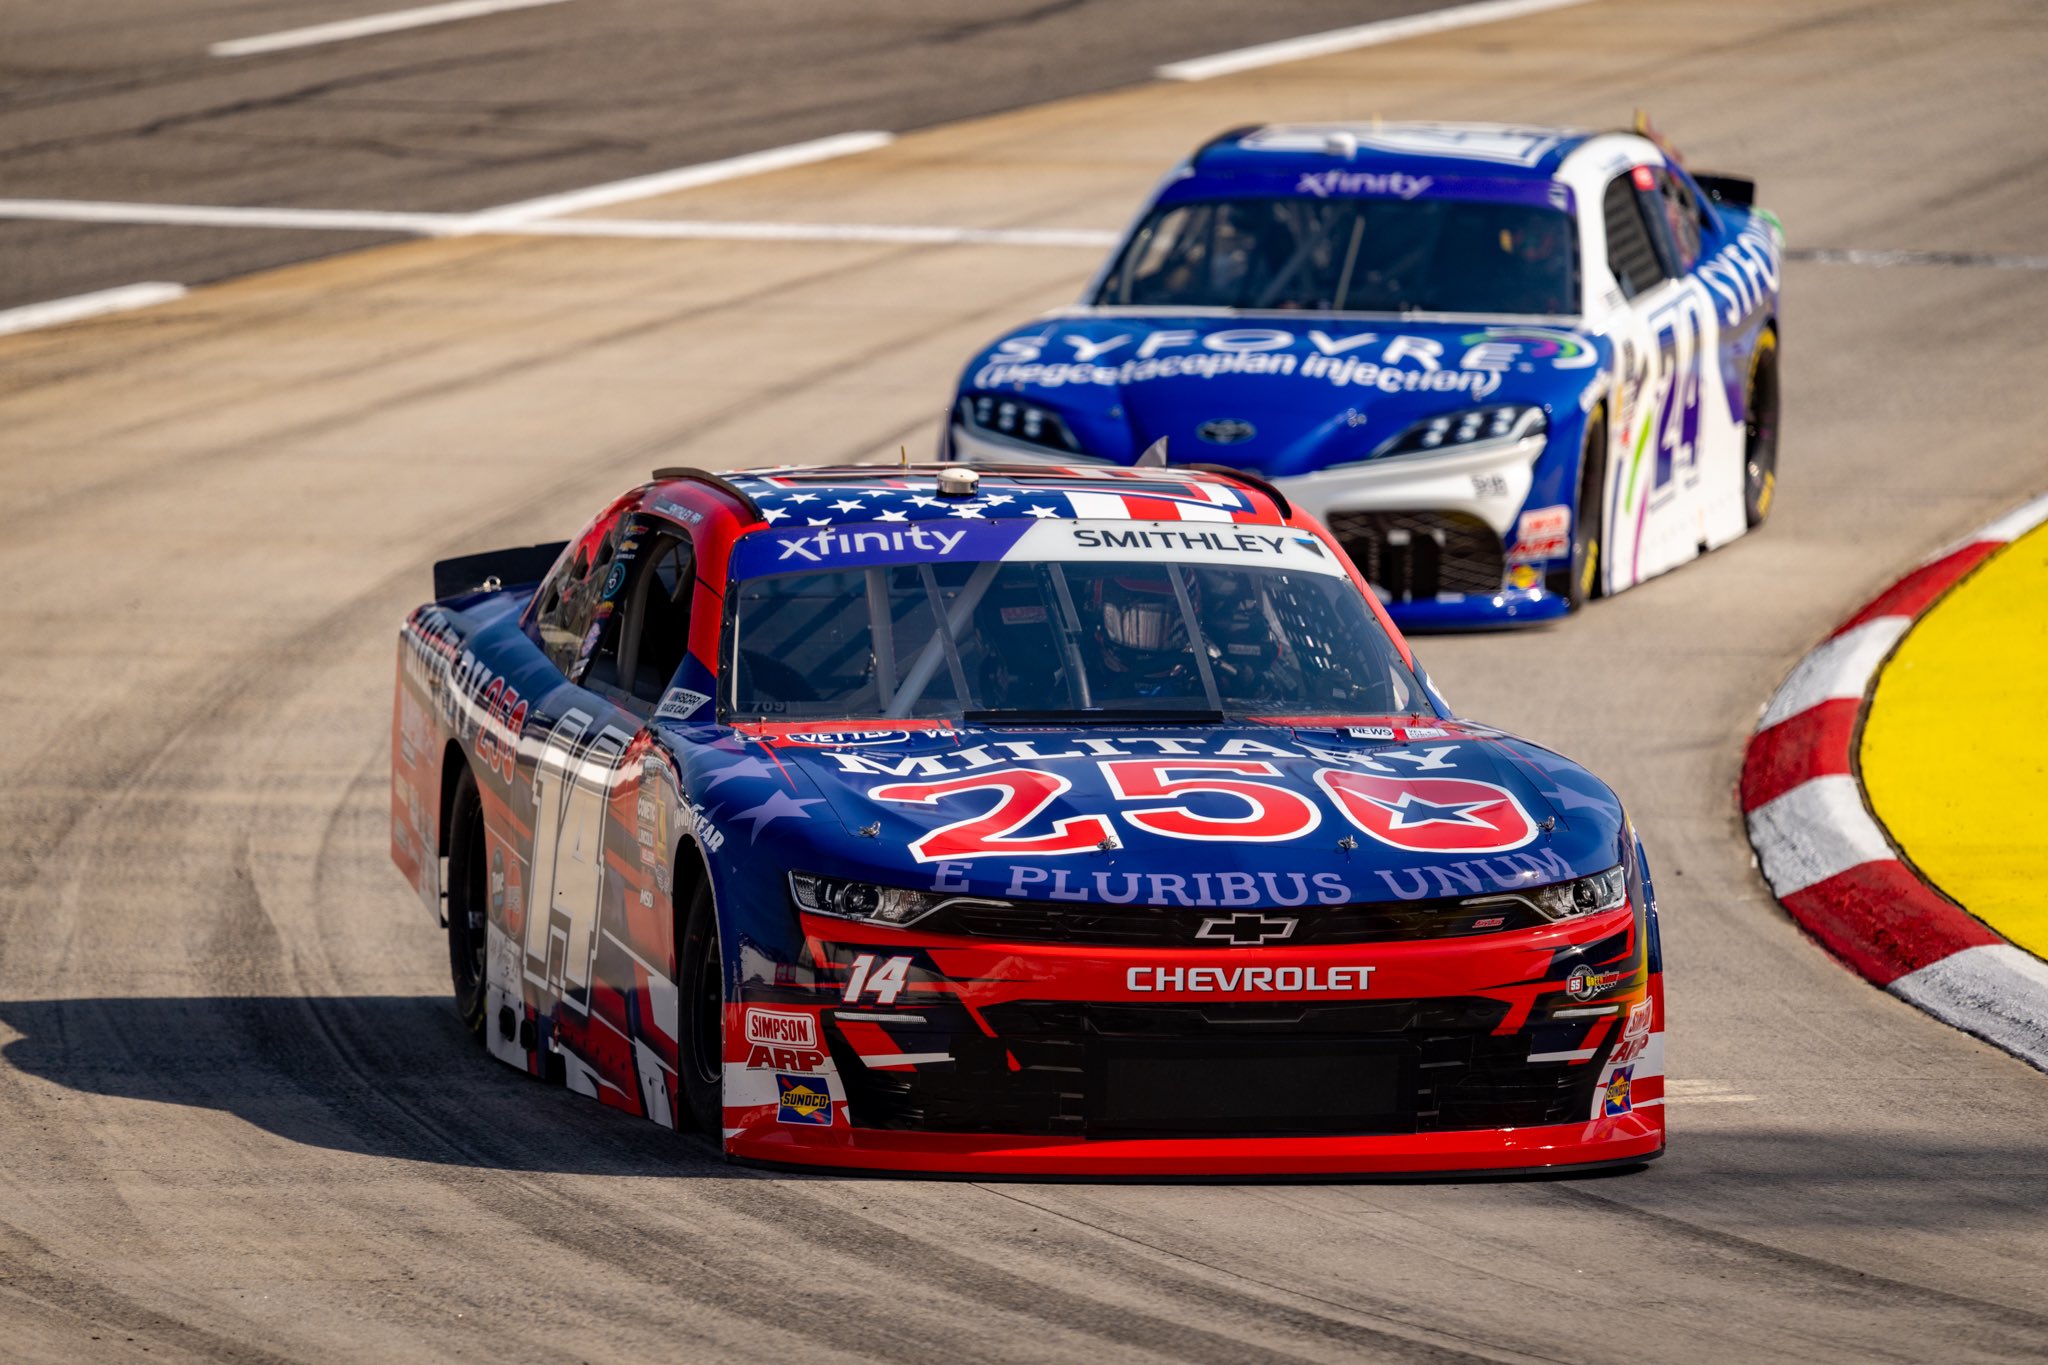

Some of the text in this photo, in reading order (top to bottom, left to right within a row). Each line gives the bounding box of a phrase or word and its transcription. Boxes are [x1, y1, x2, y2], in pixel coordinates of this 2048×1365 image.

[1296, 171, 1433, 200] xfinity
[987, 327, 1522, 371] SYFOVRE
[1300, 351, 1502, 398] injection)
[778, 528, 967, 561] xfinity
[1074, 529, 1284, 555] SMITHLEY
[751, 700, 785, 713] 709
[1352, 727, 1392, 736] NEWS
[821, 737, 1461, 777] MILITARY
[867, 758, 1540, 864] 250
[522, 706, 635, 1017] 14
[930, 848, 1578, 907] E PLURIBUS UNUM
[842, 953, 915, 1005] 14
[1126, 966, 1376, 992] CHEVROLET
[1570, 978, 1581, 991] SS
[752, 1014, 810, 1042] SIMPSON
[746, 1045, 825, 1072] ARP
[1610, 1035, 1649, 1063] ARP
[783, 1092, 828, 1109] SUNOCO
